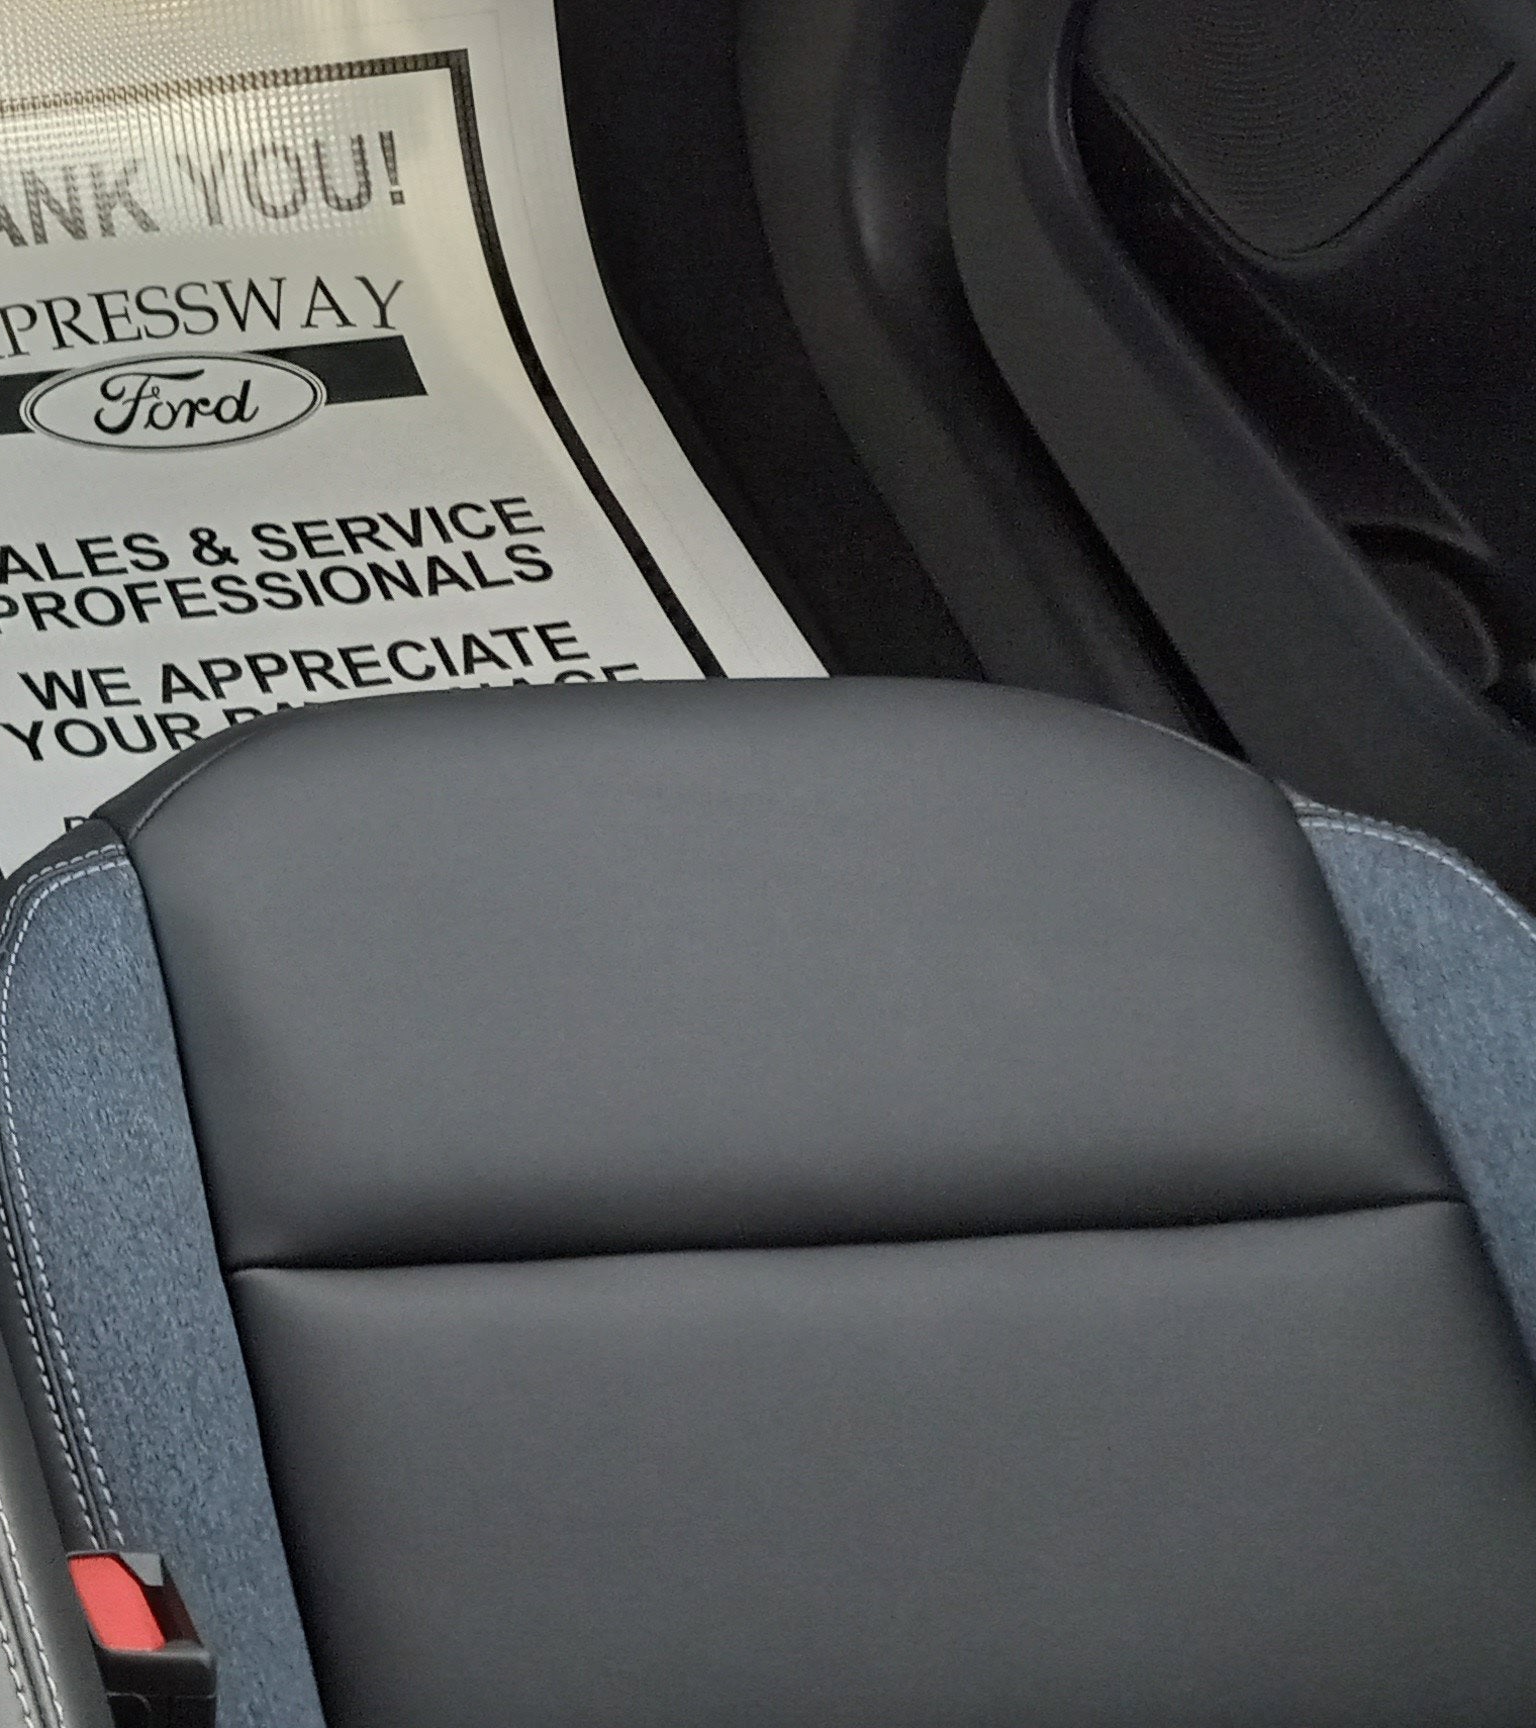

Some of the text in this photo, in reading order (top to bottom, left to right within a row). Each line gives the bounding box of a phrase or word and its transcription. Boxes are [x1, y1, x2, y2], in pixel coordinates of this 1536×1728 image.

[173, 129, 407, 226] YOU!
[92, 370, 260, 438] Ford
[190, 524, 235, 569] &
[253, 496, 546, 565] SERVICE
[16, 667, 142, 712] WE
[159, 619, 590, 707] APPRECIATE
[0, 709, 205, 763] YOUR
